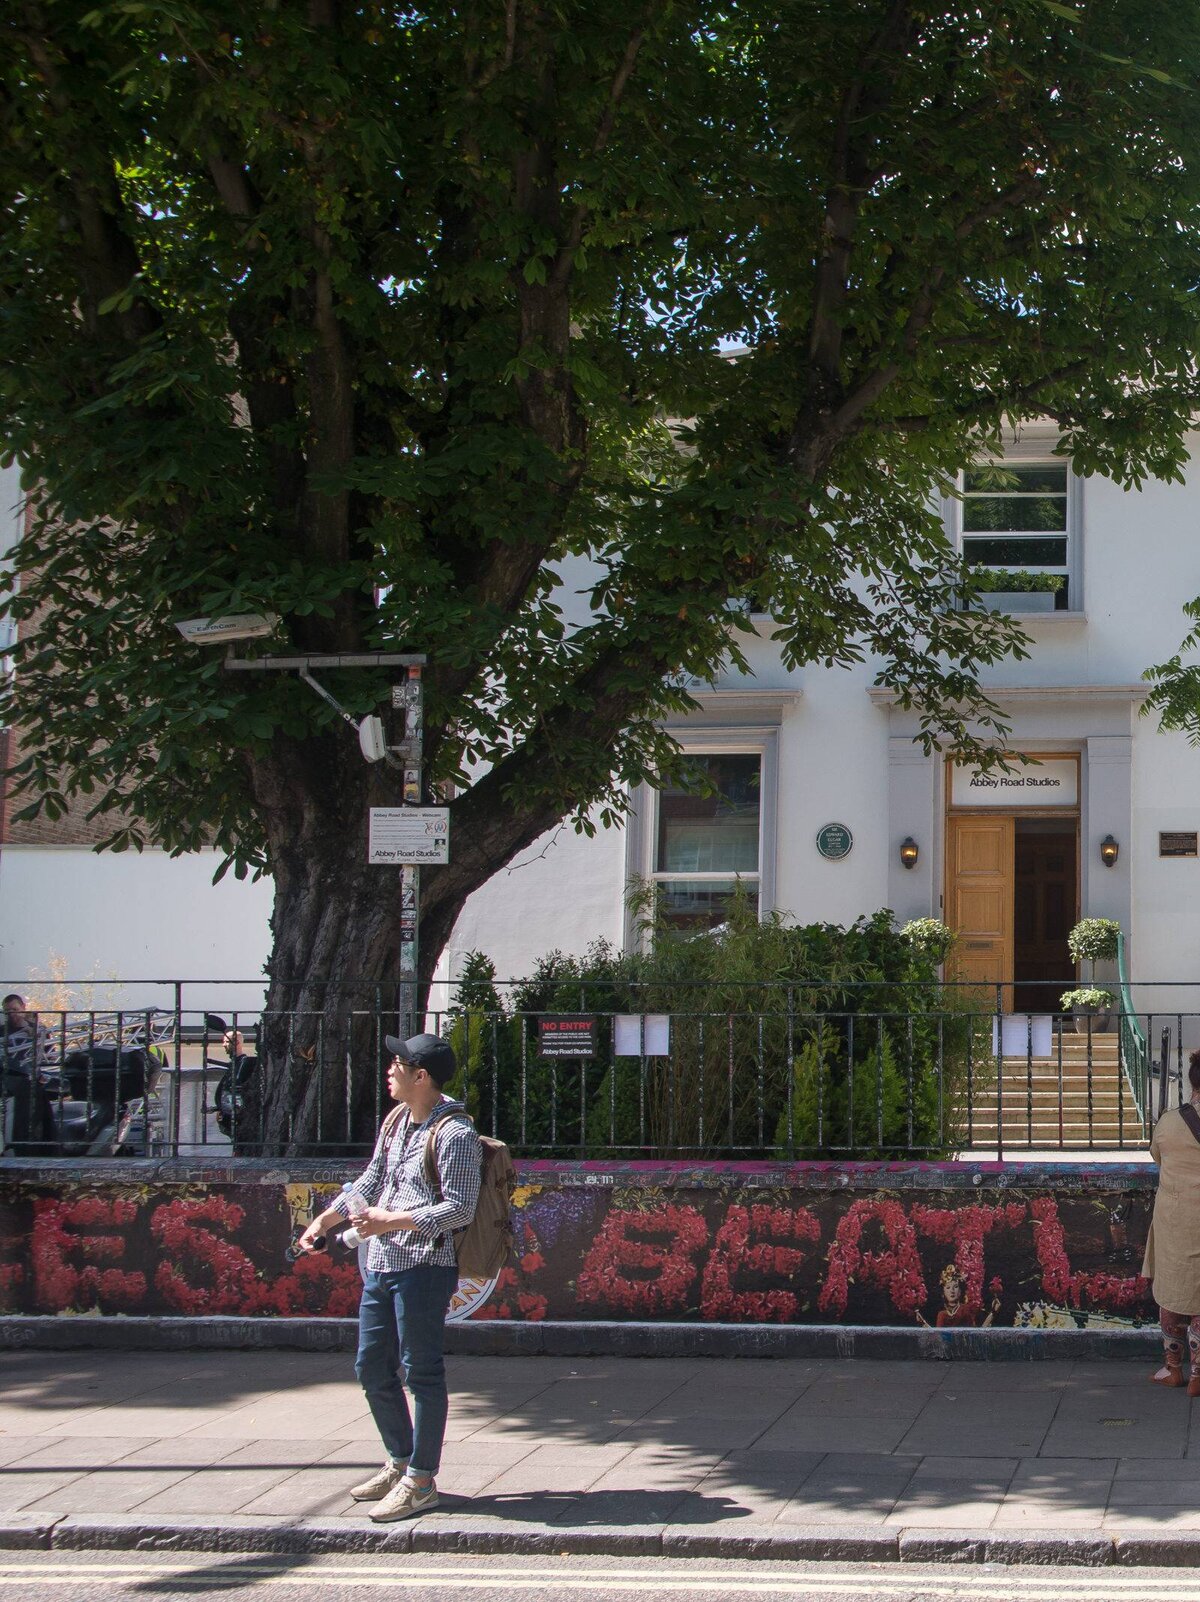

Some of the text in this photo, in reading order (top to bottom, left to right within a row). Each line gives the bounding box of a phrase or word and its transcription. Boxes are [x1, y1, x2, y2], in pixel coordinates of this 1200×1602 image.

[970, 778, 1060, 788] Abbey Road Studios
[542, 1022, 592, 1030] NO ENTRY
